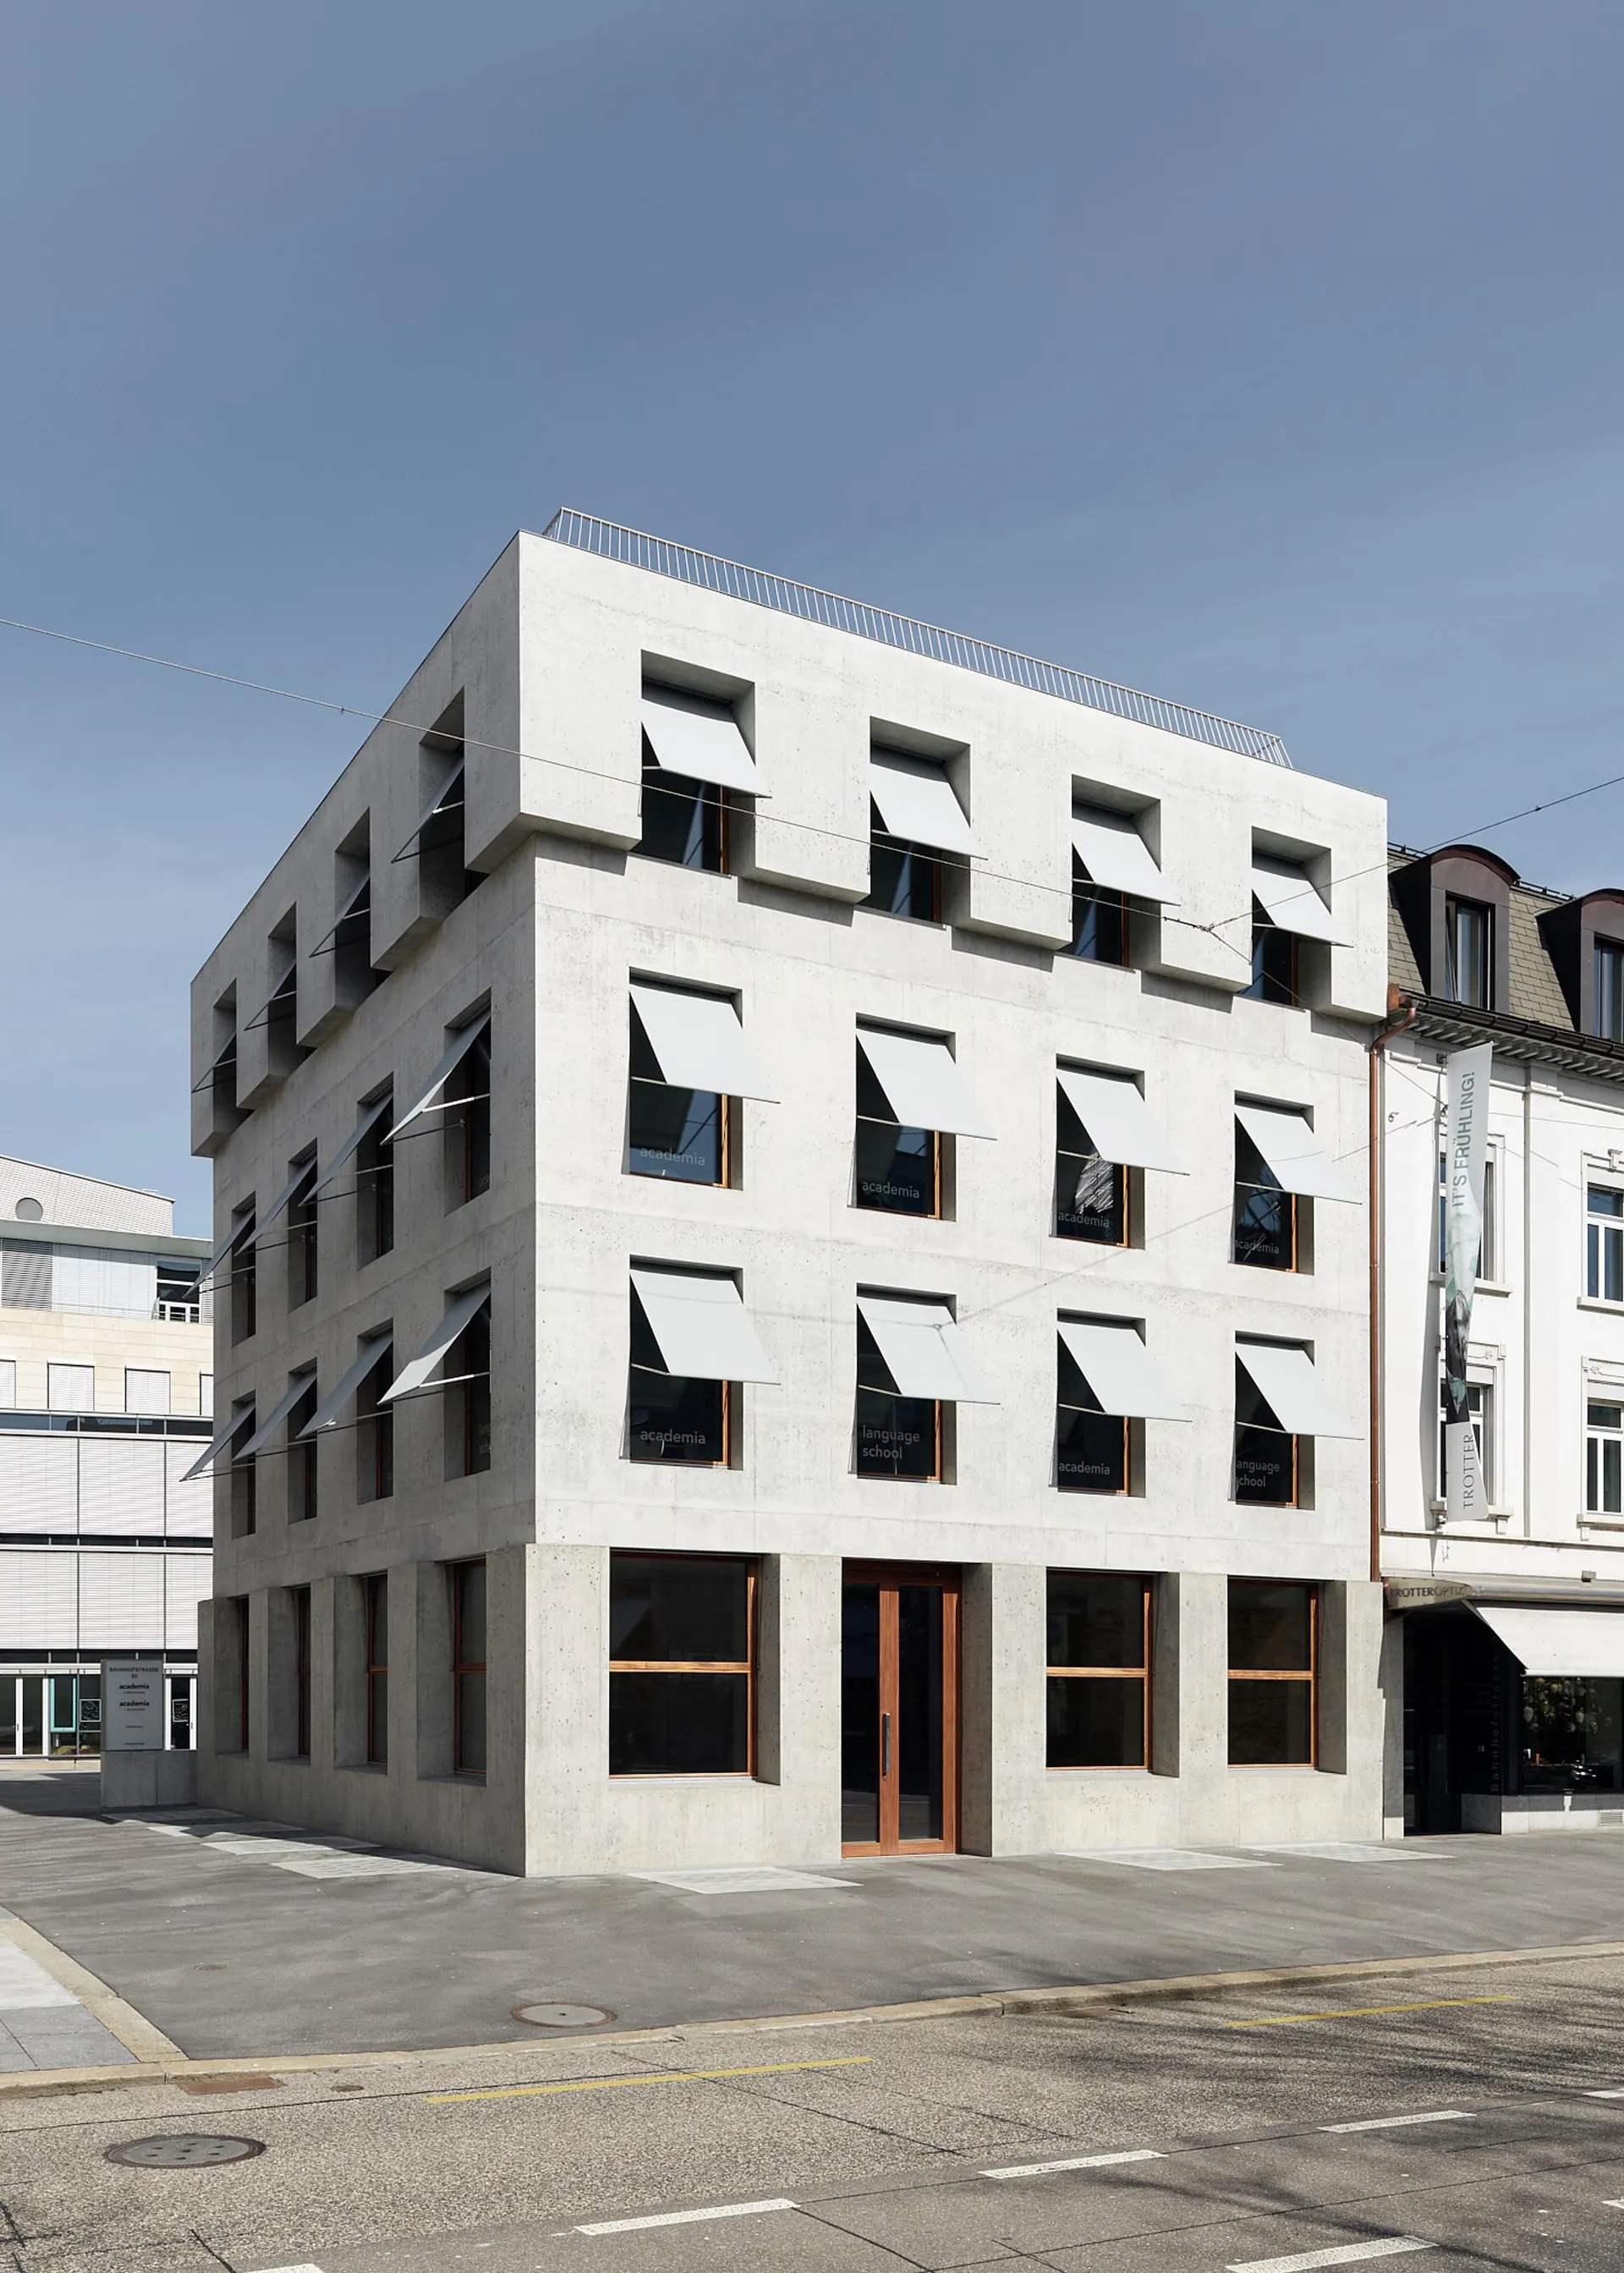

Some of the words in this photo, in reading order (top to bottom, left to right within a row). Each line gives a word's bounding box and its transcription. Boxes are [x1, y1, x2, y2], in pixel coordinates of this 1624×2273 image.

[1453, 1072, 1475, 1170] FRÜHLING!
[640, 1147, 705, 1166] academia
[862, 1182, 919, 1199] academia
[1452, 1175, 1467, 1207] IT'S
[1058, 1211, 1110, 1227] academia
[640, 1428, 706, 1445] academia
[863, 1425, 920, 1445] language
[863, 1444, 903, 1459] school
[1058, 1460, 1111, 1475] academia
[1235, 1460, 1280, 1474] anguage
[1462, 1435, 1475, 1510] TROTTER
